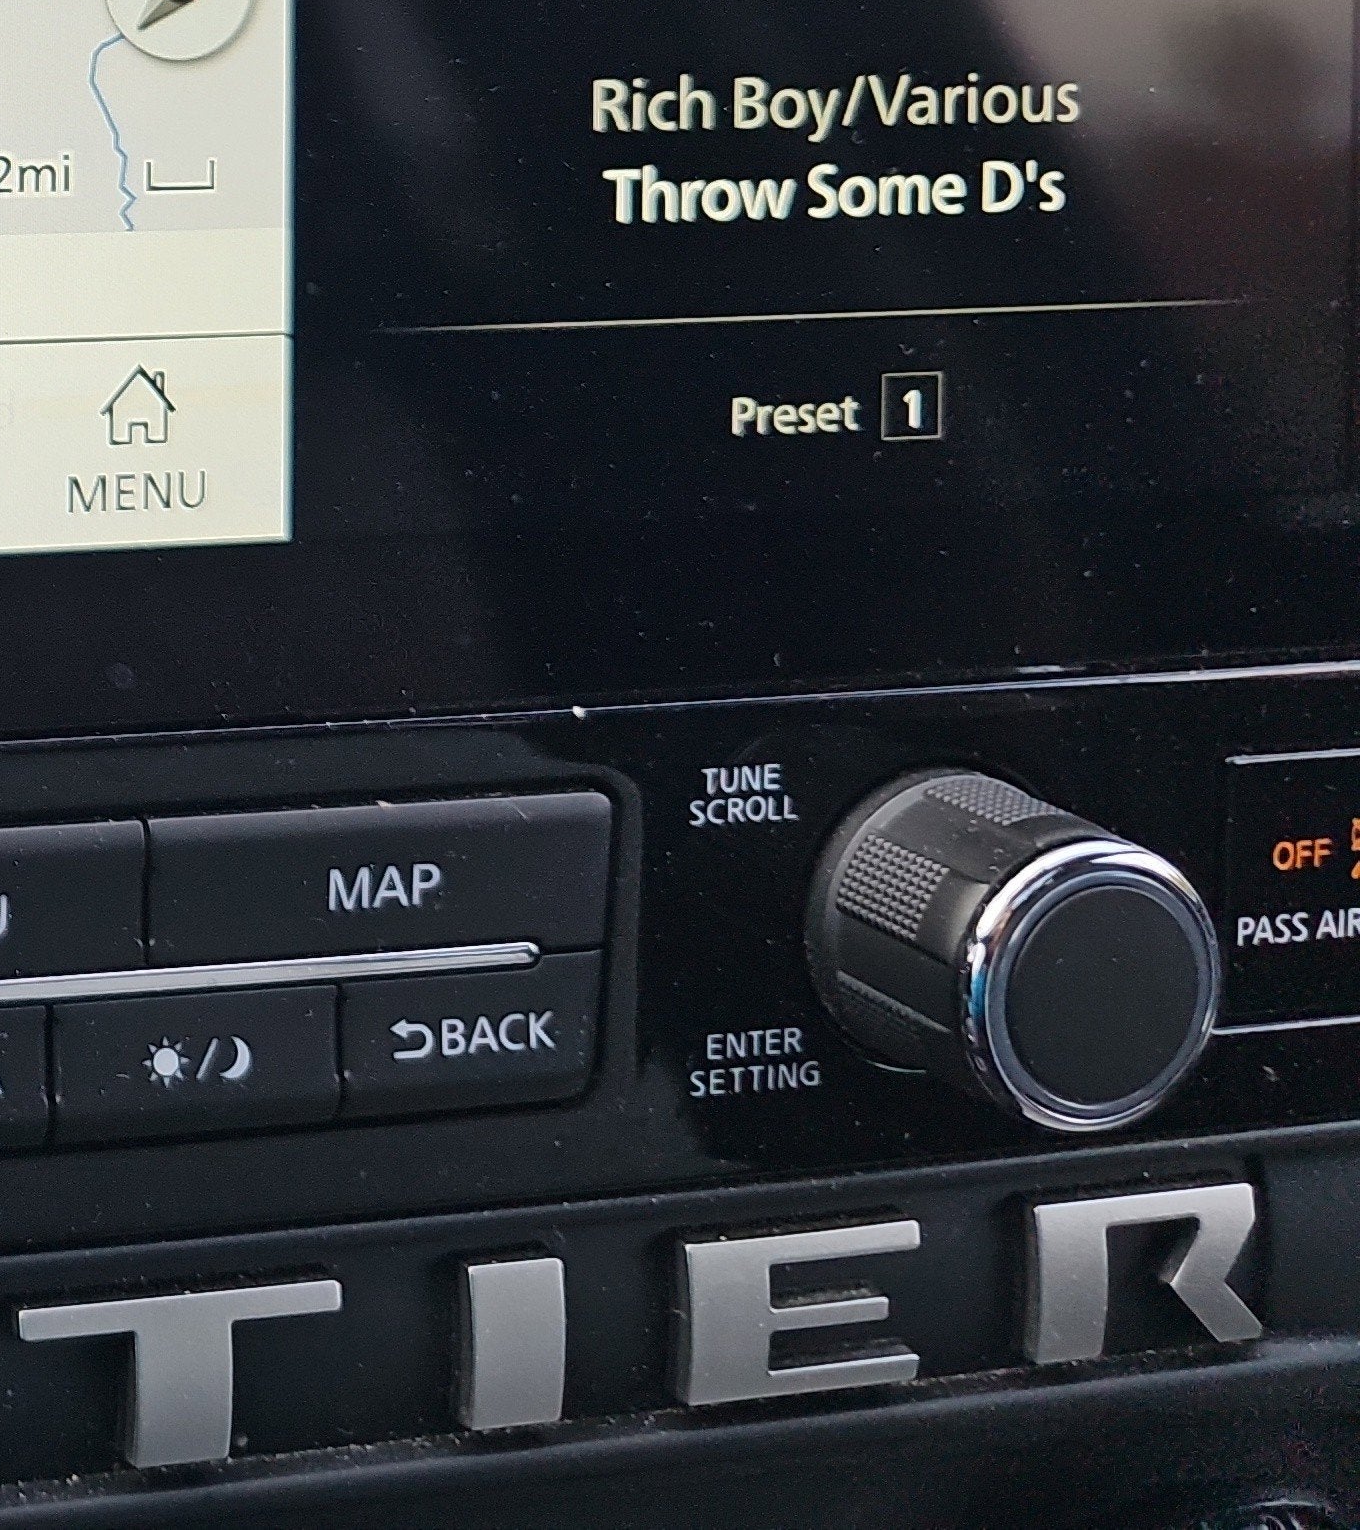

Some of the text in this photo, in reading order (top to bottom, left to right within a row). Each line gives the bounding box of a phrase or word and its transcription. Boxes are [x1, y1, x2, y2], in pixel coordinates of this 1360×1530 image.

[593, 73, 1080, 142] Rich Boy/Various
[602, 160, 1067, 224] Throw Some D's
[731, 390, 923, 437] Preset 1
[68, 471, 205, 513] MENU
[702, 764, 781, 793] TUNE
[689, 795, 799, 827] SCROLL
[1272, 837, 1332, 871] OFF
[328, 863, 442, 911] MAP
[1236, 912, 1309, 947] PASS
[441, 1011, 555, 1058] BACK
[706, 1028, 802, 1060] ENTER
[689, 1061, 820, 1098] SETTING
